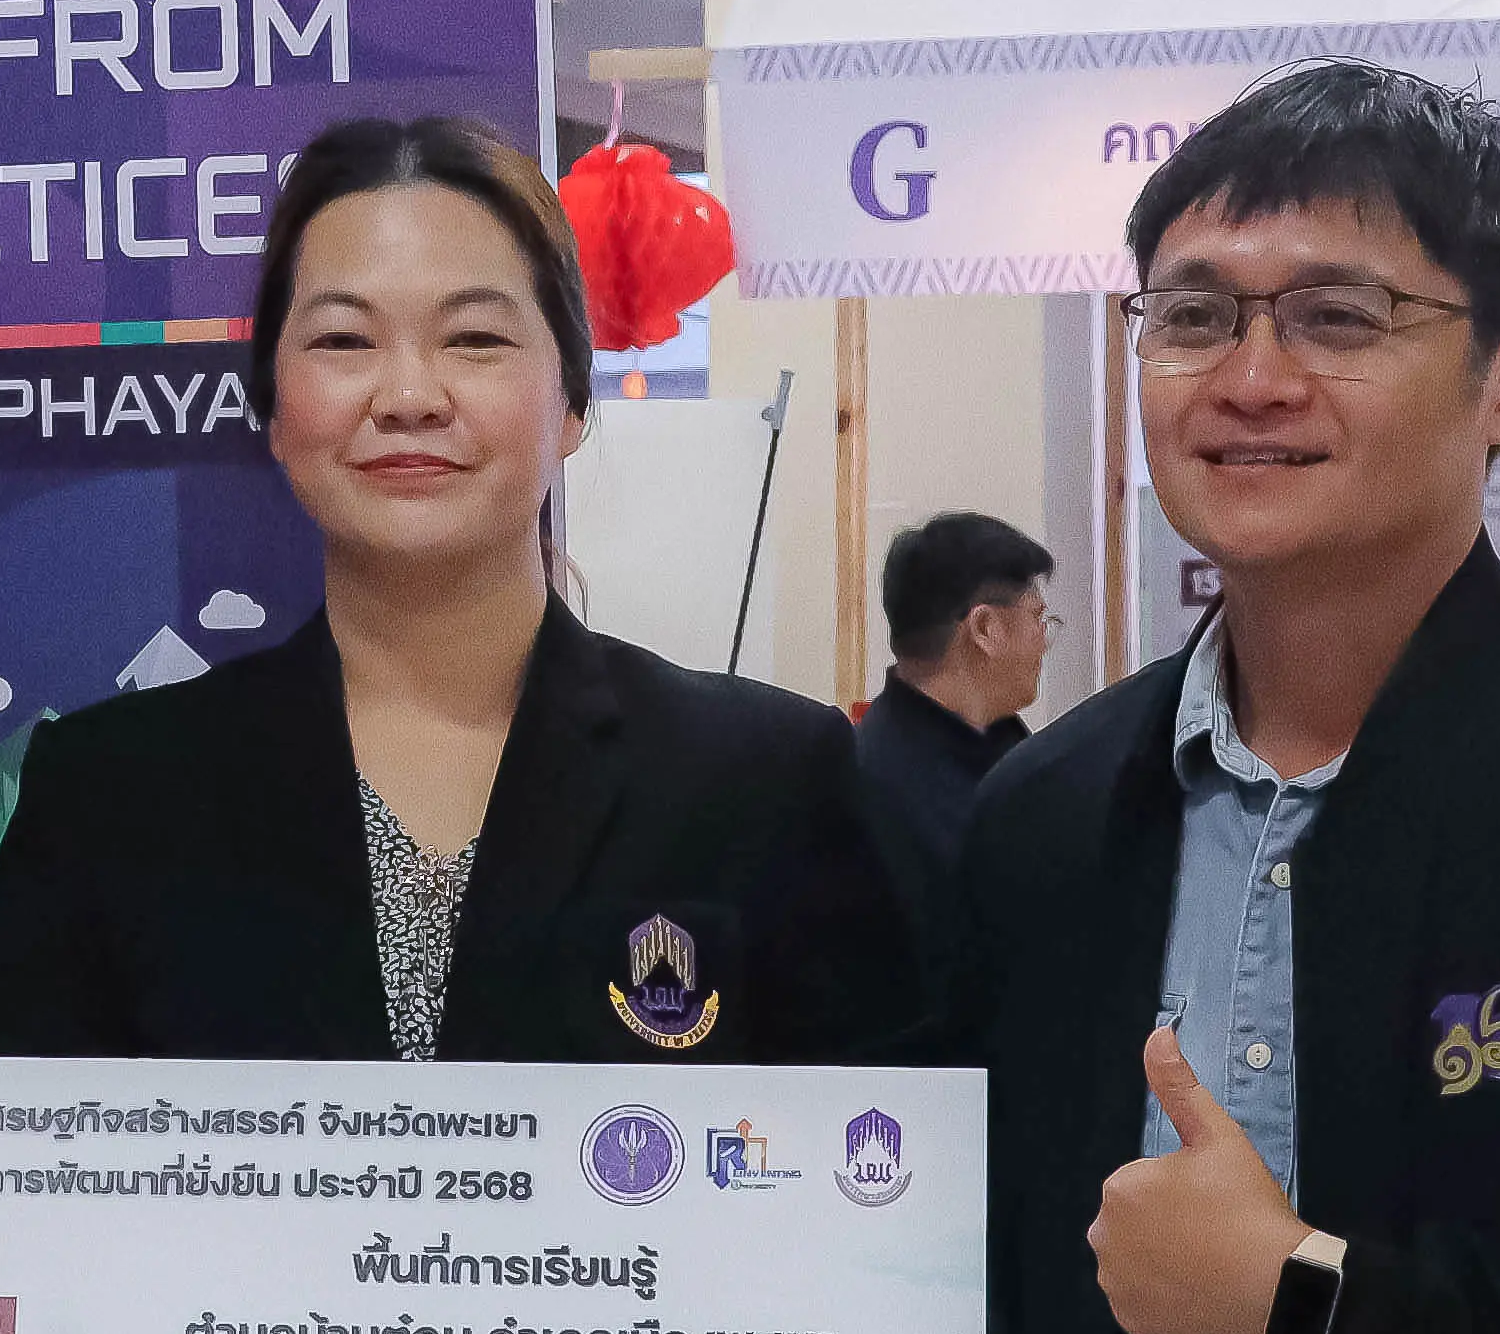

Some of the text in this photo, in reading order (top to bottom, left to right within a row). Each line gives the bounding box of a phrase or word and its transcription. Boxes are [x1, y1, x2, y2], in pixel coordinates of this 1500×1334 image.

[849, 120, 938, 223] G
[318, 1102, 540, 1140] จังหวัดพะเยา
[294, 1164, 424, 1200] ประจำปี
[435, 1170, 535, 1203] 2568
[352, 1232, 660, 1302] พื้นที่การเรียนรู้
